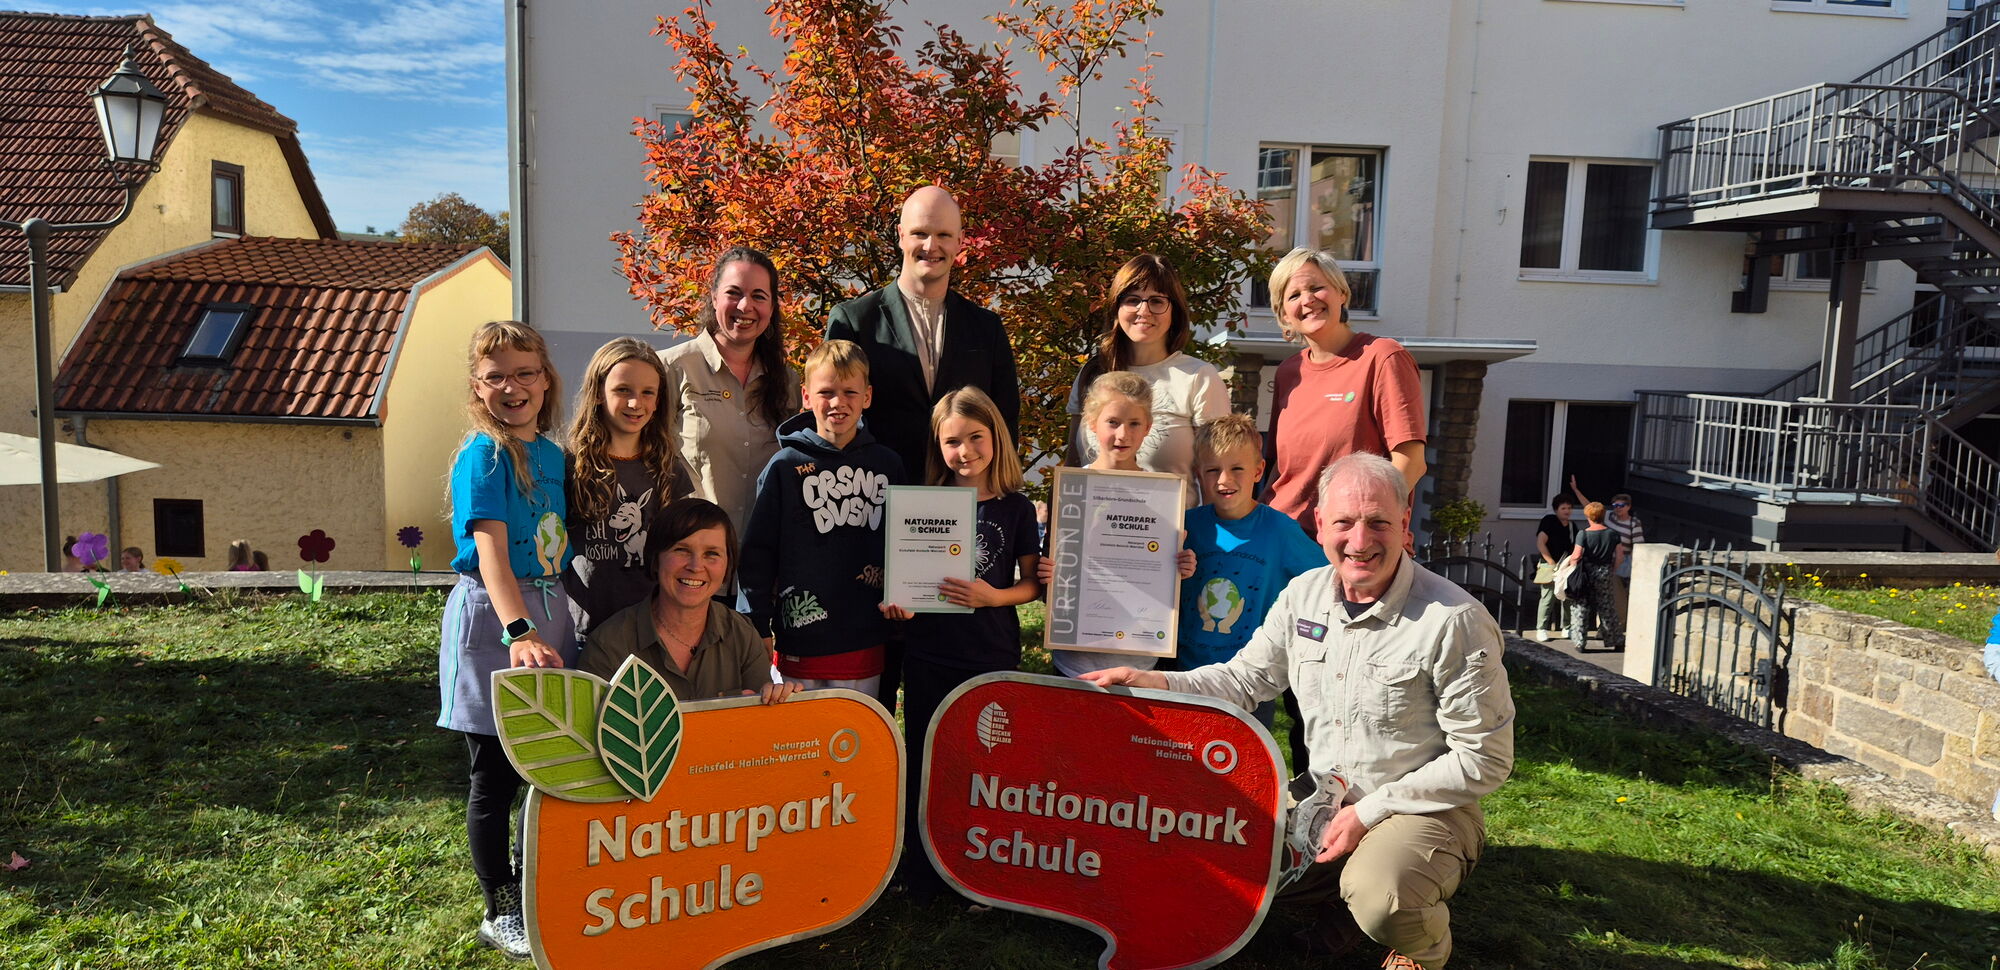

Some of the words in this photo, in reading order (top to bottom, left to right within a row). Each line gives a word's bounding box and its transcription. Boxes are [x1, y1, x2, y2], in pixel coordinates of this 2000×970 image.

[802, 465, 888, 509] CRSNG
[813, 496, 883, 534] DVSN
[904, 518, 957, 526] NATURPARK
[1106, 514, 1157, 524] NATURPARK
[1119, 522, 1149, 531] SCHULE
[586, 519, 608, 541] ESEL
[918, 526, 950, 534] SCHULE
[1054, 483, 1083, 634] URKUNDE
[773, 738, 821, 752] Naturpark
[1130, 734, 1195, 751] Nationalpark
[689, 760, 735, 775] Eichsfeld
[739, 749, 820, 769] Hainich-Werratal
[1156, 749, 1193, 762] Hainich
[969, 773, 1249, 847] Nationalpark
[587, 782, 858, 867] Naturpark
[964, 826, 1101, 877] Schule
[582, 864, 764, 937] Schule
